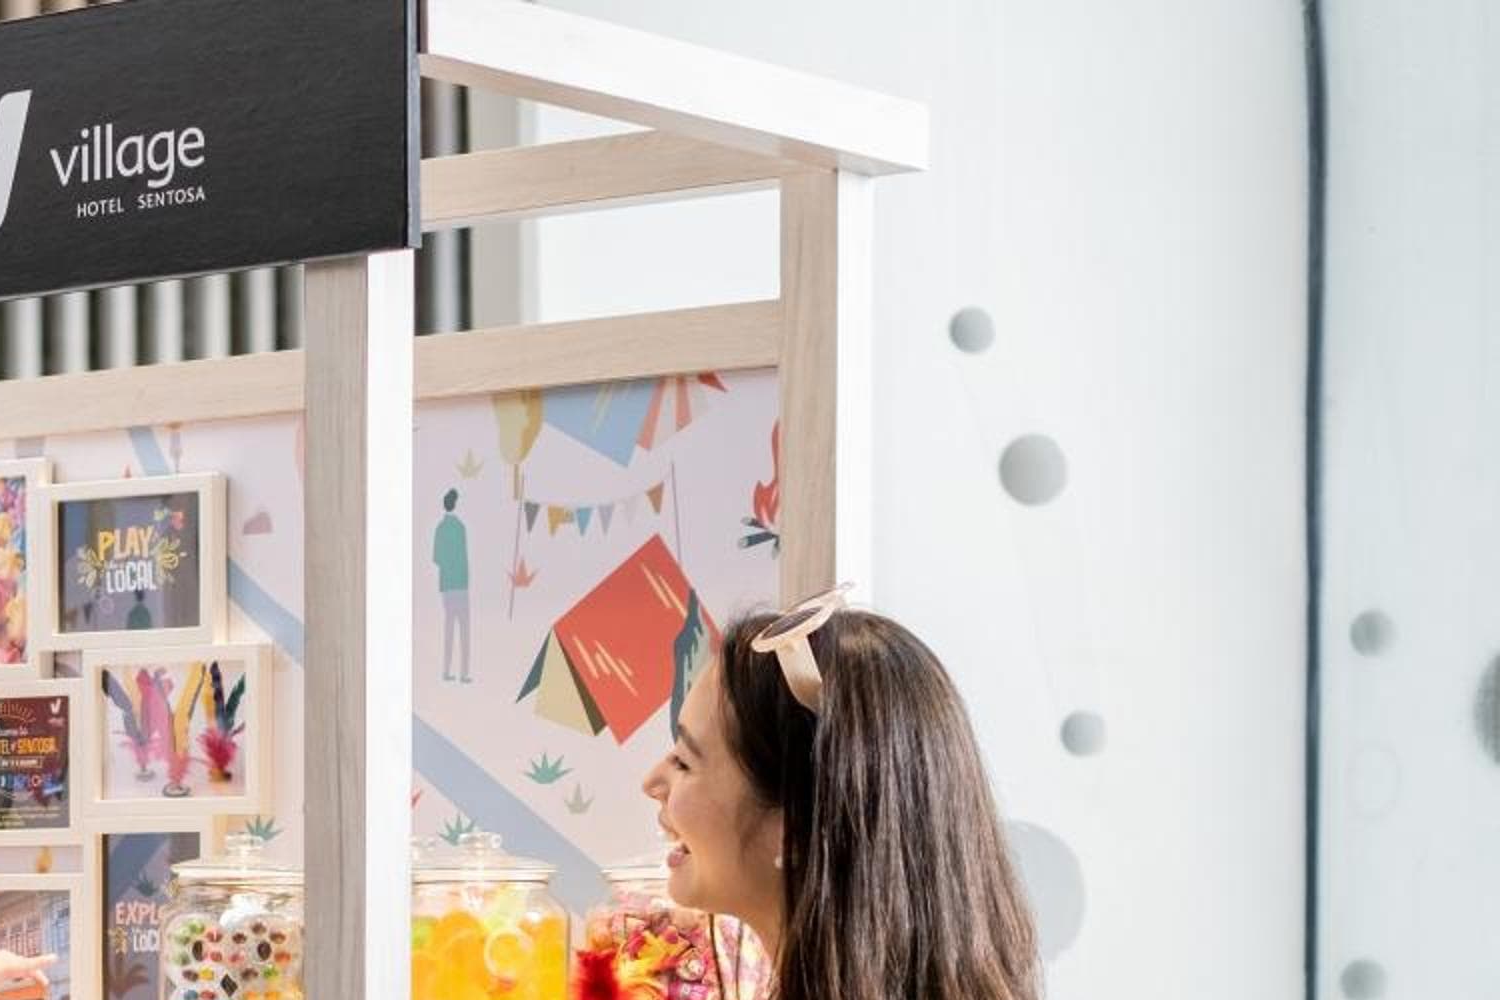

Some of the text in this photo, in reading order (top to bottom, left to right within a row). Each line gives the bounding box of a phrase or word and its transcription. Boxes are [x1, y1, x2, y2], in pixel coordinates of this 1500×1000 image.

[50, 123, 205, 188] village
[77, 186, 206, 218] HOTEL SENTOSA
[98, 525, 154, 562] PLAY
[106, 560, 157, 594] LOCAL
